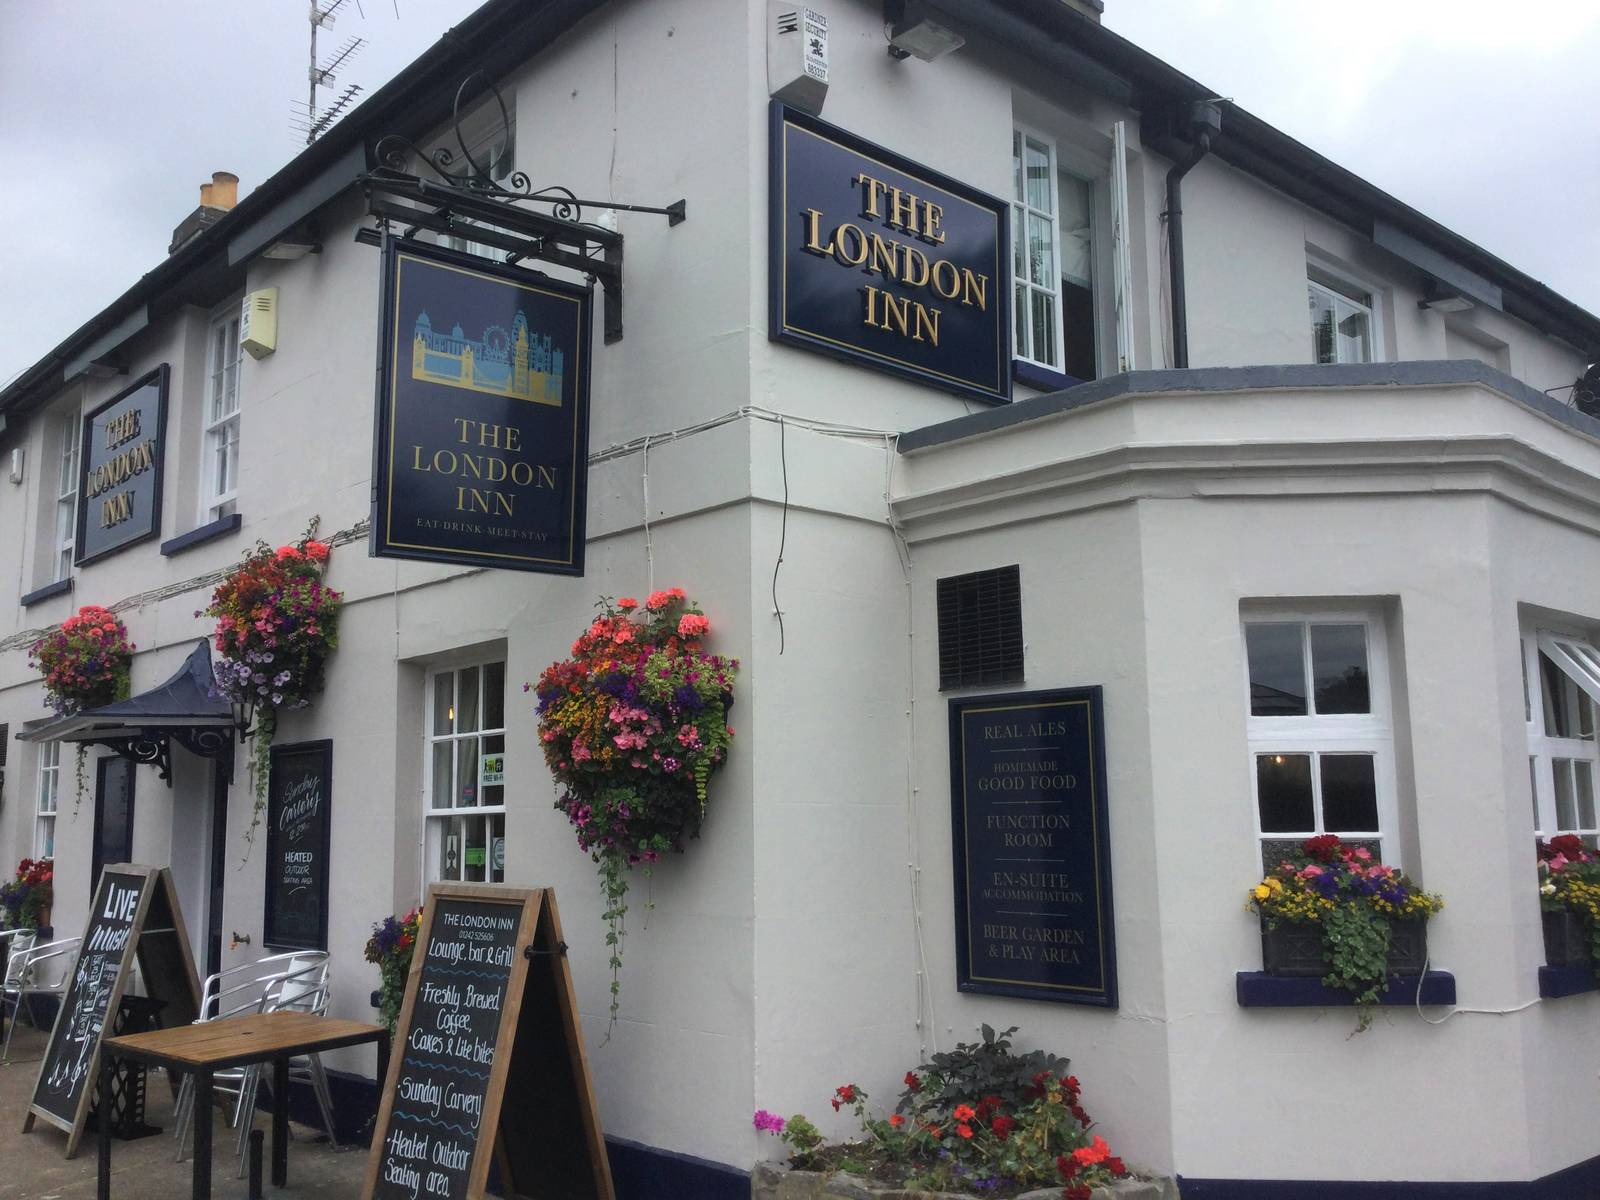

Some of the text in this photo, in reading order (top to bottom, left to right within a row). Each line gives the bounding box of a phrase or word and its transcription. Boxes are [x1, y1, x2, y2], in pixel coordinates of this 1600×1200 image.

[805, 21, 827, 40] SECURITY
[859, 173, 945, 244] THE
[807, 208, 988, 311] LONDON
[864, 285, 941, 346] INN
[105, 408, 141, 449] THE
[454, 417, 521, 452] THE
[86, 440, 154, 497] LONDON
[411, 445, 557, 490] LONDON
[101, 491, 134, 528] INN
[456, 486, 516, 517] INN
[443, 521, 482, 534] DRINK
[487, 526, 518, 538] MEET
[984, 721, 1066, 739] REAL ALES
[993, 761, 1058, 772] HOMEMADE
[978, 775, 1077, 791] GOOD FOOD
[986, 815, 1072, 830] FUNCTION
[1004, 833, 1053, 847] ROOM
[285, 852, 313, 863] HEATED
[983, 887, 1084, 902] ACCOMMODATION
[993, 872, 1069, 888] EN-SUITE
[444, 913, 514, 930] THE LONDON INN
[983, 924, 1085, 944] BEER GARDEN
[468, 941, 487, 962] bar
[495, 944, 515, 968] Grill
[988, 944, 1080, 964] & PLAY AREA
[423, 982, 500, 1013] Freshly Brewed
[412, 1027, 443, 1054] Cakes
[455, 1036, 473, 1060] Lite
[473, 1036, 495, 1065] bites
[400, 1076, 482, 1129] Sunday Carvery
[390, 1129, 429, 1160] Heated
[384, 1157, 451, 1200] Seating area
